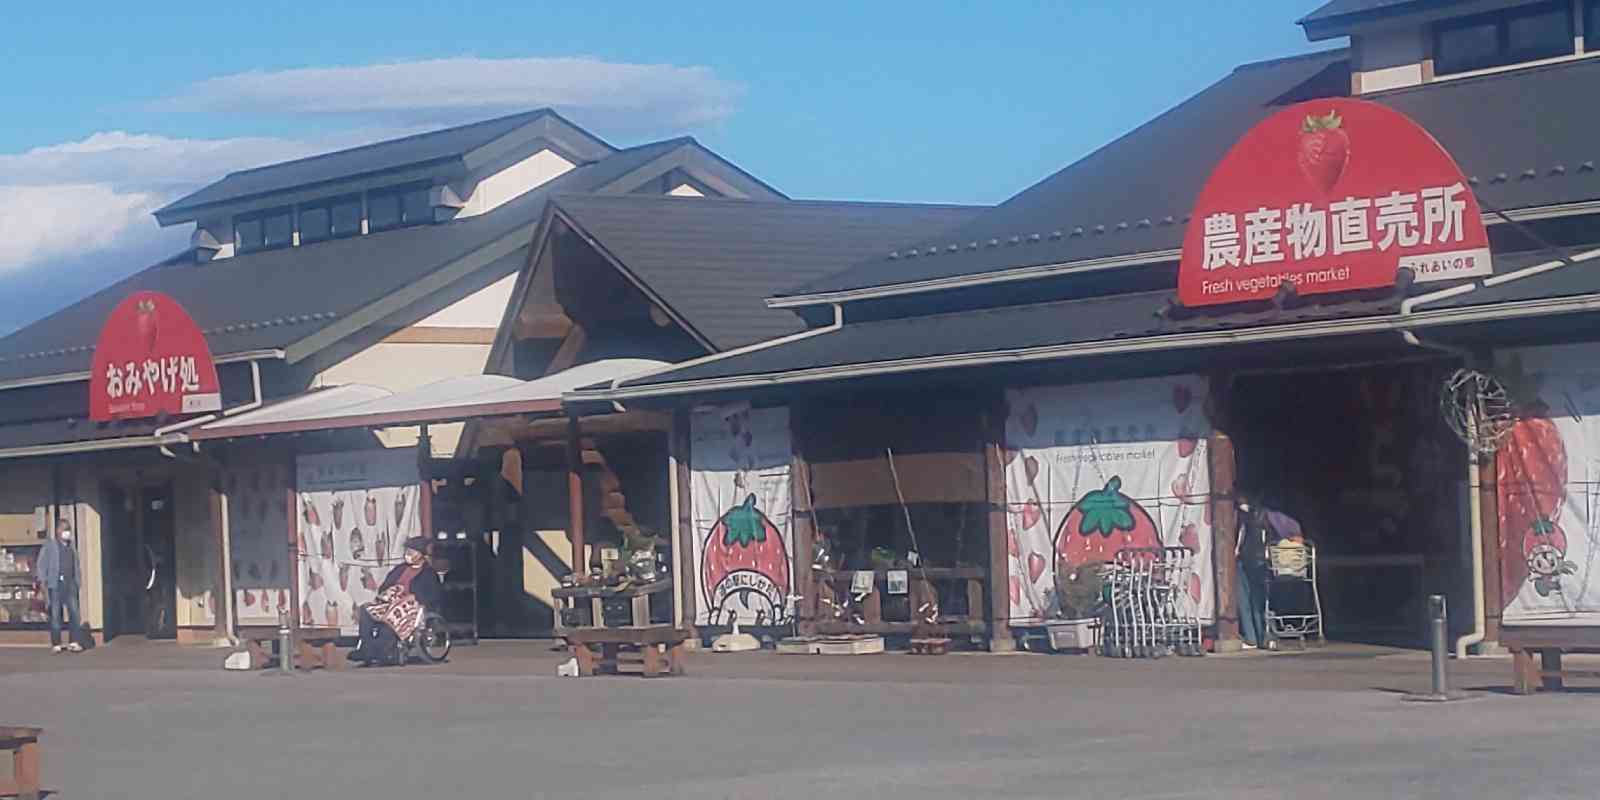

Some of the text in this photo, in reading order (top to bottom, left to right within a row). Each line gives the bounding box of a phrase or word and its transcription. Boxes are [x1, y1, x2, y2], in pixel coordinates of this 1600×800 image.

[1201, 182, 1466, 271] 農産物直売所
[1202, 279, 1233, 295] Fresh
[1306, 266, 1350, 283] market
[106, 356, 199, 398] おみやげ処
